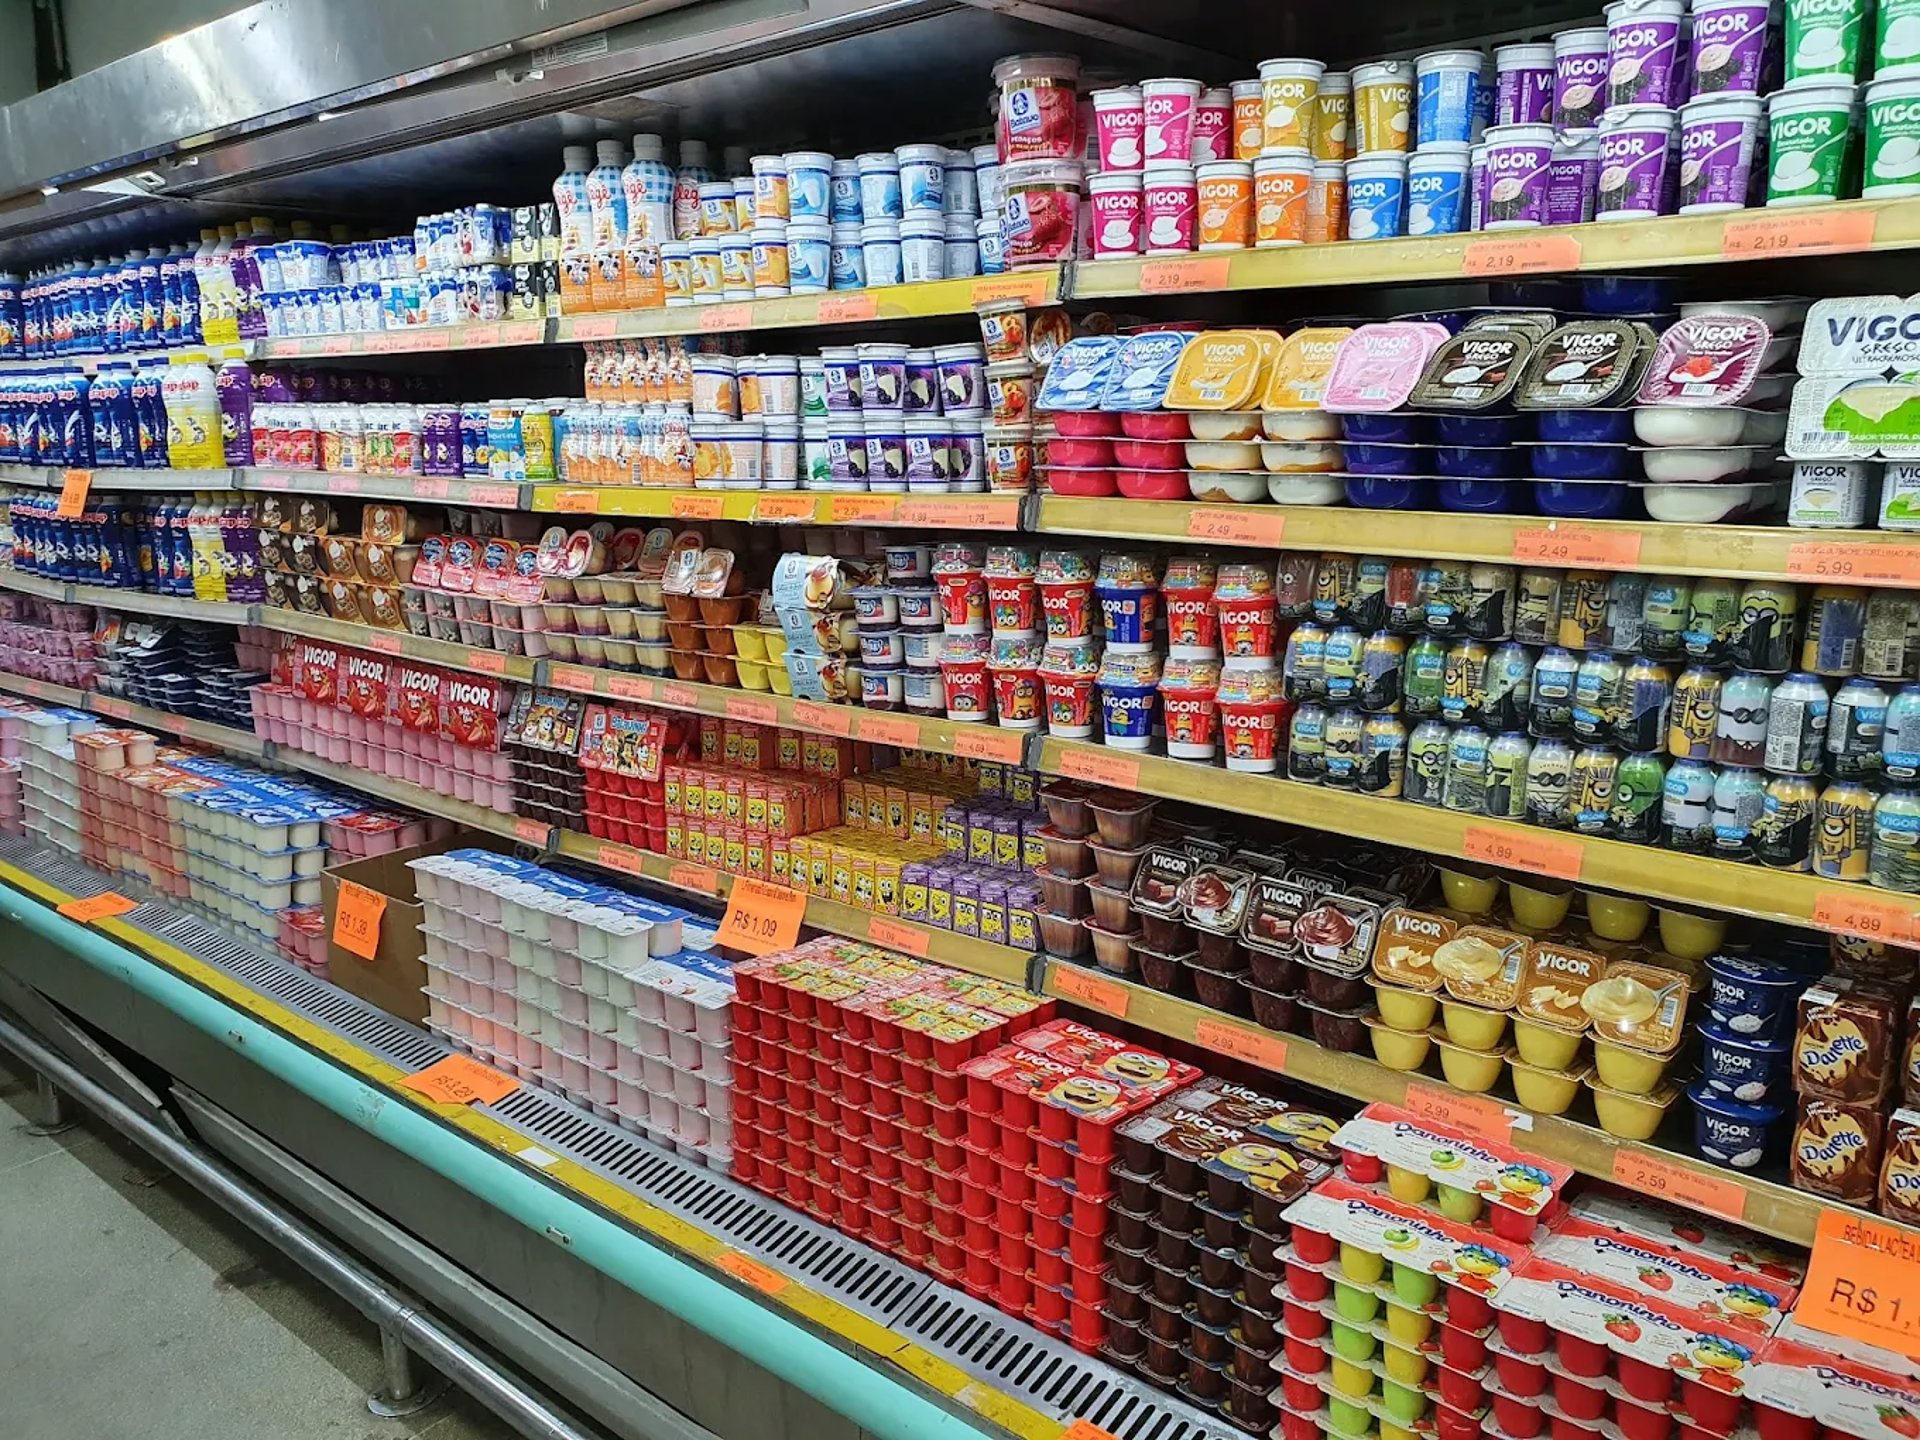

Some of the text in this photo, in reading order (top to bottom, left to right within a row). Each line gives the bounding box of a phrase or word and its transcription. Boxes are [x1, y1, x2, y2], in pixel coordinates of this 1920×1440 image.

[1693, 13, 1749, 39] VIGOR
[1607, 29, 1659, 51] VIGOR
[1557, 59, 1608, 79] VIGOR
[1262, 84, 1305, 99] VIGOR
[1771, 116, 1831, 142] VIGOR
[1486, 152, 1538, 173] VIGOR
[1550, 165, 1582, 176] VIGOR
[1096, 195, 1138, 210] VIGOR
[1147, 191, 1188, 206] VIGOR
[1753, 235, 1788, 250] 2,19
[1486, 254, 1514, 268] 2,19
[1158, 274, 1180, 286] 2,19
[1363, 336, 1410, 349] VIGOR
[1562, 333, 1617, 349] VIGOR
[1687, 326, 1752, 342] VIGOR
[1072, 345, 1108, 358] VIGOR
[1133, 341, 1173, 354] VIGOR
[1203, 344, 1246, 356] VIGOR
[1461, 341, 1513, 354] VIGOR
[1861, 341, 1919, 355] GREGO
[1800, 465, 1847, 478] VIGOR
[1207, 523, 1230, 536] 2,49
[1538, 544, 1568, 558] 2,49
[1816, 561, 1853, 576] 5,99
[304, 645, 336, 668] VIGOR
[349, 657, 383, 681] VIGOR
[945, 672, 982, 685] VIGOR
[1541, 671, 1570, 684] VIGOR
[401, 669, 439, 695] VIGOR
[450, 682, 489, 708] VIGOR
[1886, 755, 1918, 765] VIGOR
[1882, 815, 1919, 829] VIGOR
[1152, 852, 1187, 874] VIGOR
[1485, 846, 1513, 860] 4,89
[1262, 885, 1303, 908] VIGOR
[752, 917, 778, 937] 1,09
[1395, 913, 1441, 938] VIGOR
[1844, 915, 1881, 931] 4,89
[1538, 951, 1591, 977] VIGOR
[1712, 978, 1745, 1000] VIGOR
[1066, 1024, 1126, 1050] VIGOR
[1711, 1047, 1752, 1069] VIGOR
[1803, 1032, 1866, 1066] Danette
[1014, 1050, 1076, 1077] VIGOR
[1221, 1084, 1289, 1111] VIGOR
[1424, 1102, 1450, 1119] 2,99
[1173, 1109, 1244, 1142] VIGOR
[1705, 1116, 1750, 1138] VIGOR
[1395, 1121, 1498, 1165] Danoninho
[1802, 1131, 1866, 1161] Danette
[1636, 1171, 1666, 1190] 2,59
[1347, 1200, 1455, 1243] Danoninho
[1844, 1225, 1880, 1249] BEBIDA
[1594, 1237, 1713, 1282] Danoninho
[1556, 1280, 1682, 1332] Danoninho
[1830, 1277, 1878, 1315] R$
